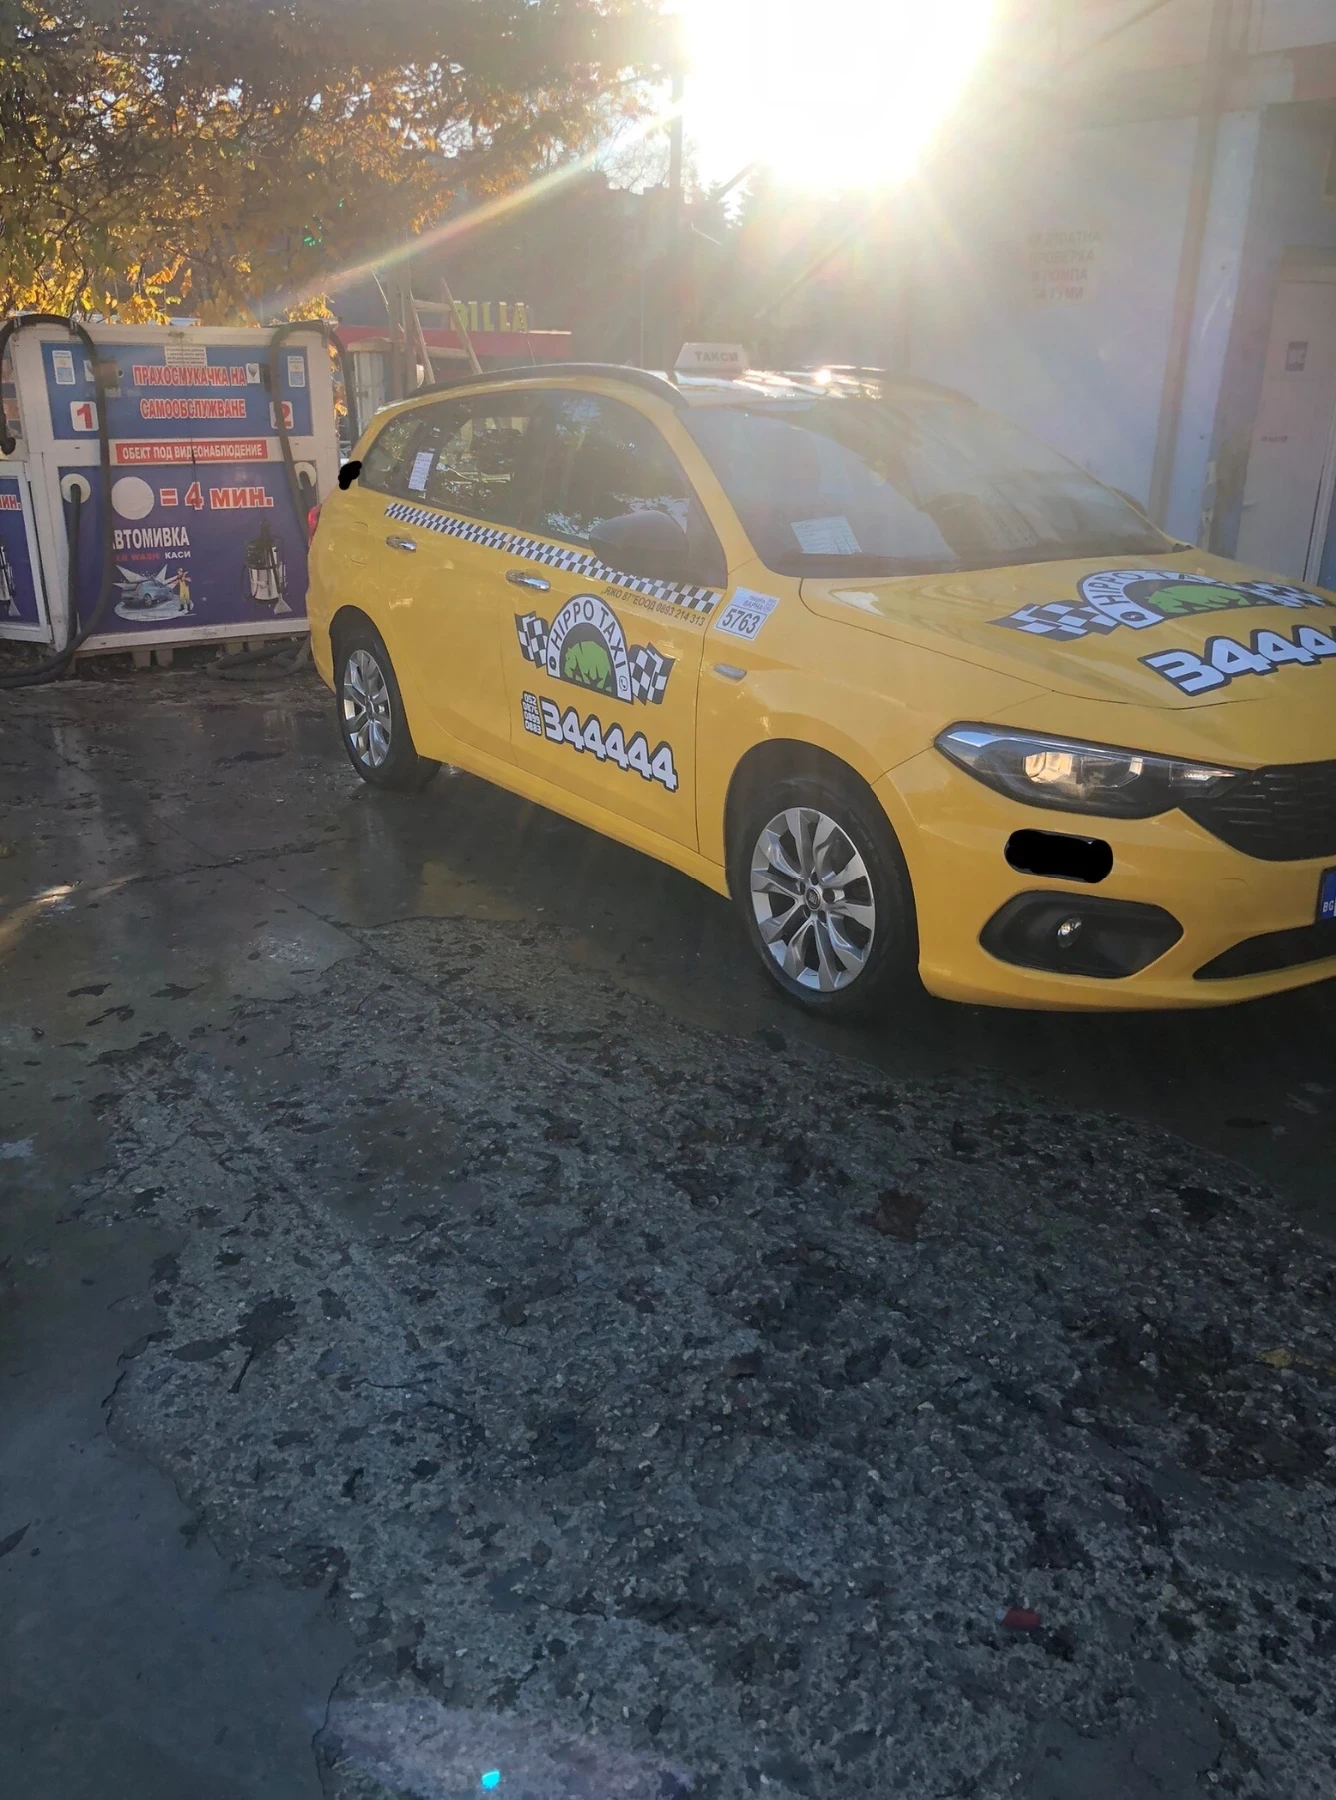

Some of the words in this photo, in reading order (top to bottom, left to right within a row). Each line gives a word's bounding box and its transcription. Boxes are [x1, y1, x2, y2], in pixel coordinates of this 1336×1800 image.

[450, 300, 528, 332] BILLA
[694, 351, 739, 362] ТАКСИ
[132, 364, 230, 387] ПРАХОСМУКАЧКА
[230, 366, 247, 387] НА
[76, 403, 93, 429] 1
[140, 399, 247, 420] САМООБСЛУЖВАНЕ
[122, 446, 151, 460] ОБЕКТ
[153, 446, 173, 460] ПОД
[174, 443, 263, 460] ВИДЕОНАБЛЮДЕНИЕ
[184, 481, 204, 511] 4
[112, 526, 190, 550] ВТОМИВКА
[130, 551, 161, 562] WASH
[164, 551, 191, 560] КАСИ
[1088, 572, 1145, 606] HIPPO
[655, 602, 675, 618] 0893
[674, 609, 690, 622] 214
[689, 613, 706, 628] 313
[743, 600, 764, 611] ВАРНА
[722, 607, 761, 635] 5763
[551, 600, 595, 651] HIPPO
[600, 607, 627, 669] TAXI
[1138, 626, 1336, 696] 3444
[524, 692, 538, 705] 052
[540, 697, 679, 792] 344444
[1323, 900, 1334, 912] BG
